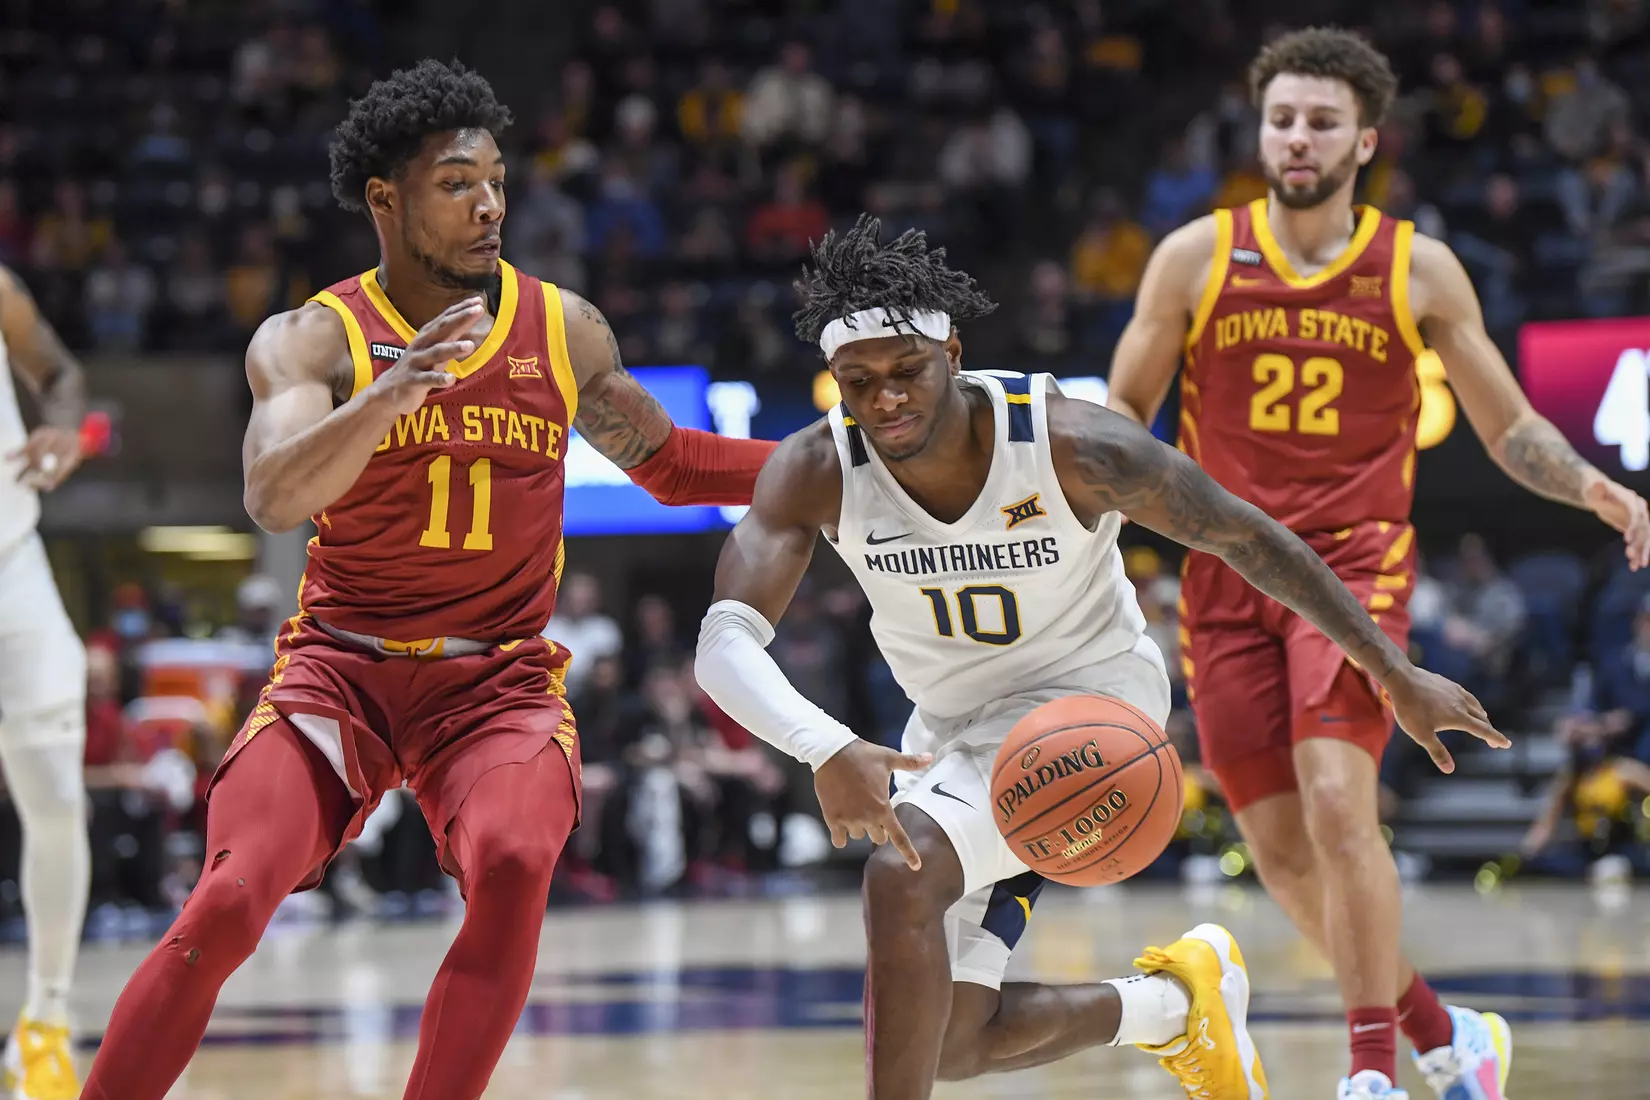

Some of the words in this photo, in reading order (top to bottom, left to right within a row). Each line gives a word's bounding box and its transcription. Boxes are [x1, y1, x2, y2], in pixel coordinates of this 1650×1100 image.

[1215, 308, 1288, 350] IOWA
[1299, 308, 1389, 363] STATE
[1249, 353, 1344, 436] 22
[462, 405, 563, 461] STATE
[419, 454, 493, 551] 11
[1001, 494, 1047, 531] XII
[864, 537, 1060, 575] MOUNTAINEERS
[919, 583, 1023, 646] 10
[997, 739, 1104, 824] SPALDING
